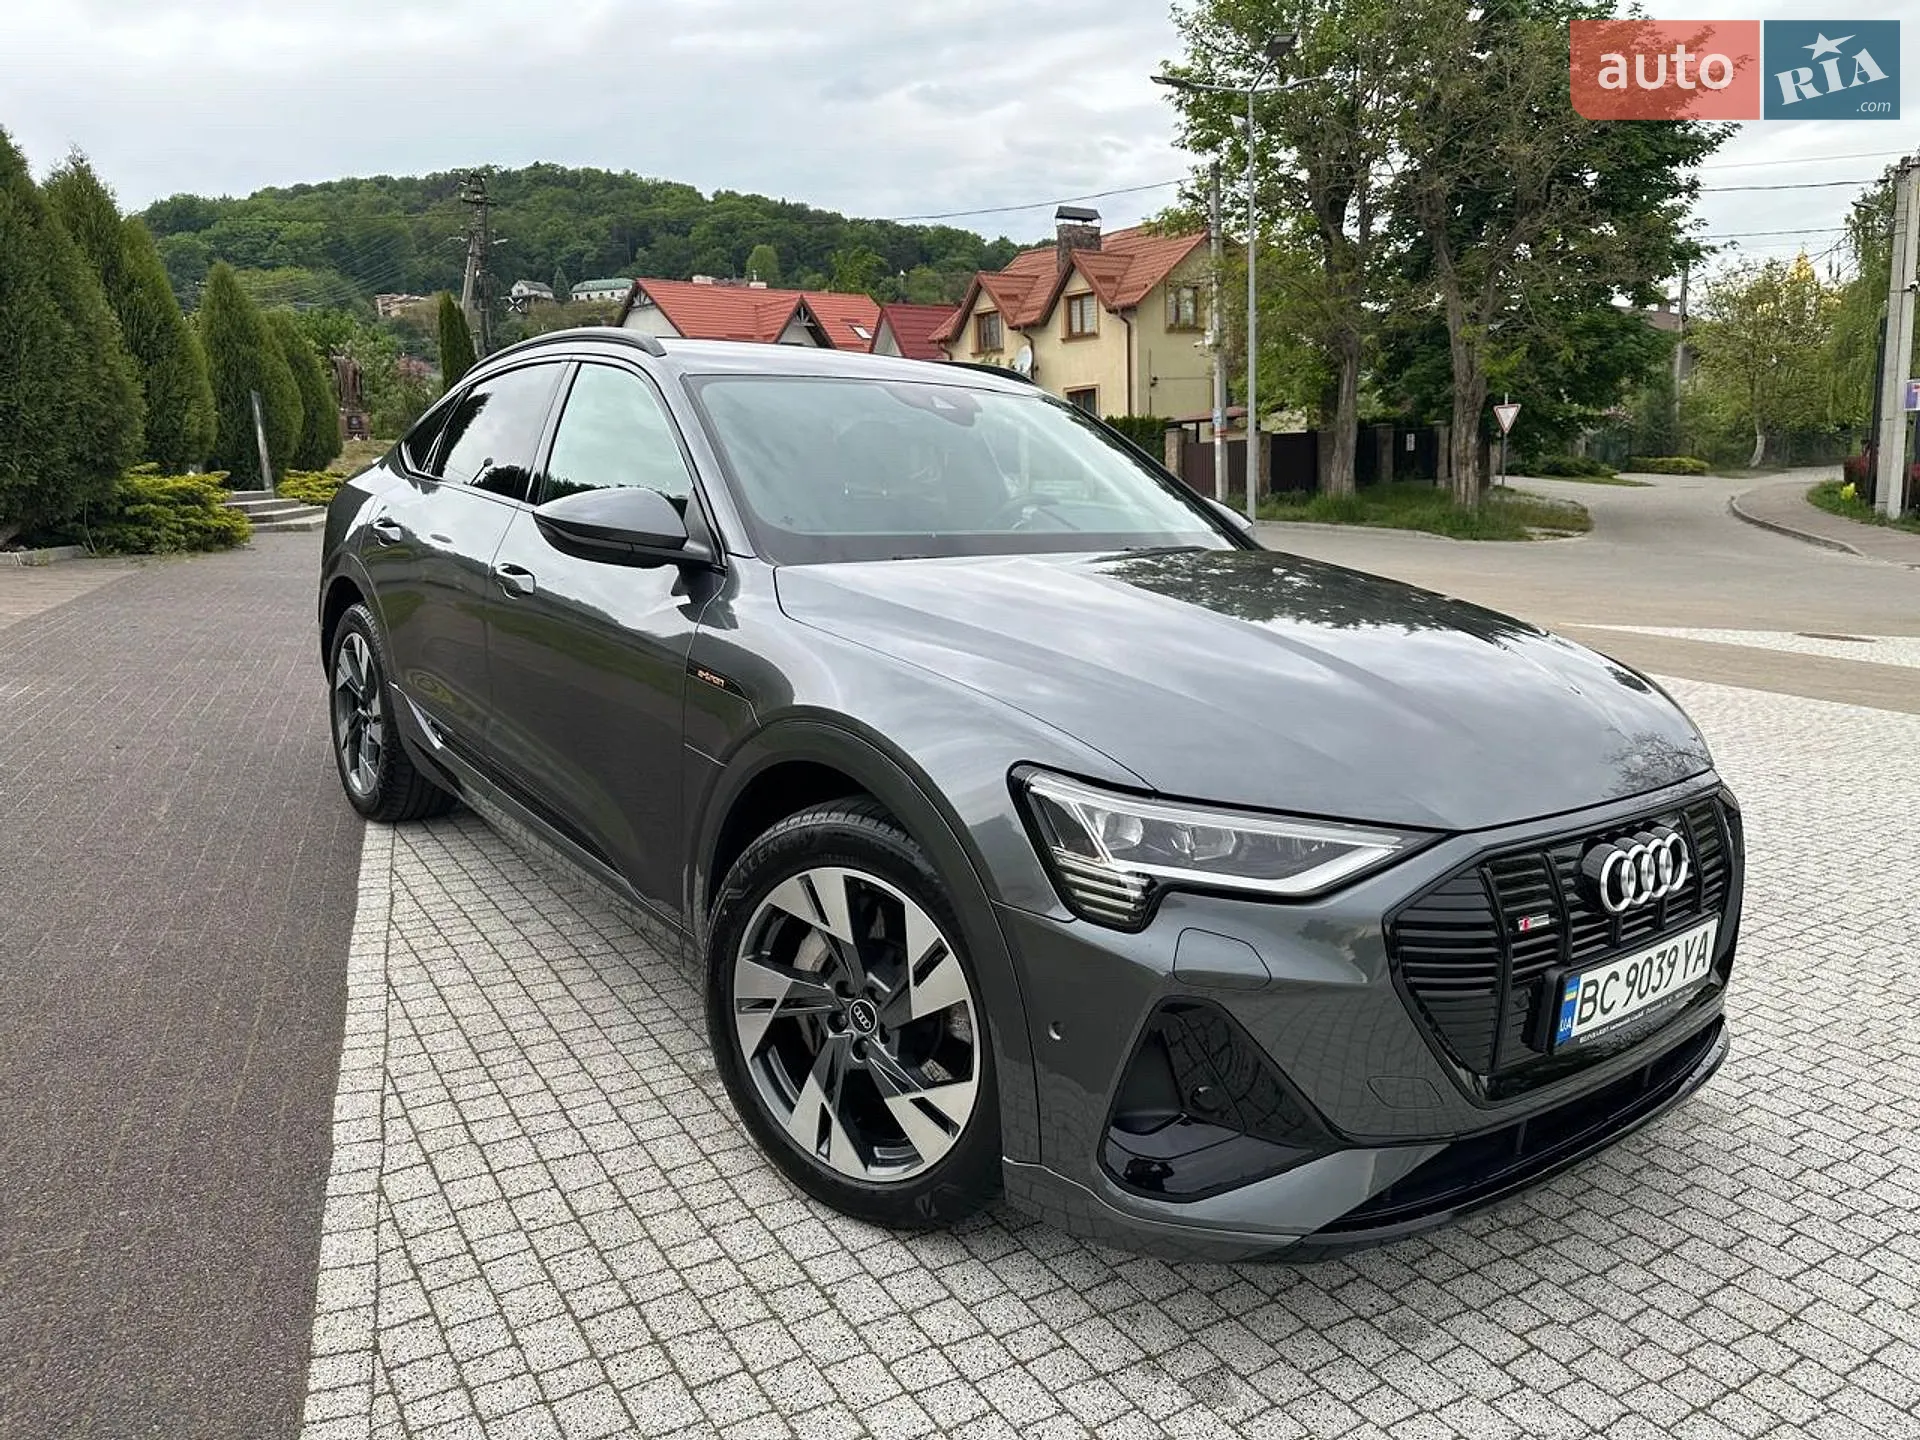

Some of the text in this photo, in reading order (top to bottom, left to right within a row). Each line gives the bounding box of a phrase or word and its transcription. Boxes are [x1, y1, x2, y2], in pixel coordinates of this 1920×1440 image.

[1576, 930, 1709, 1026] BC 9039 YA
